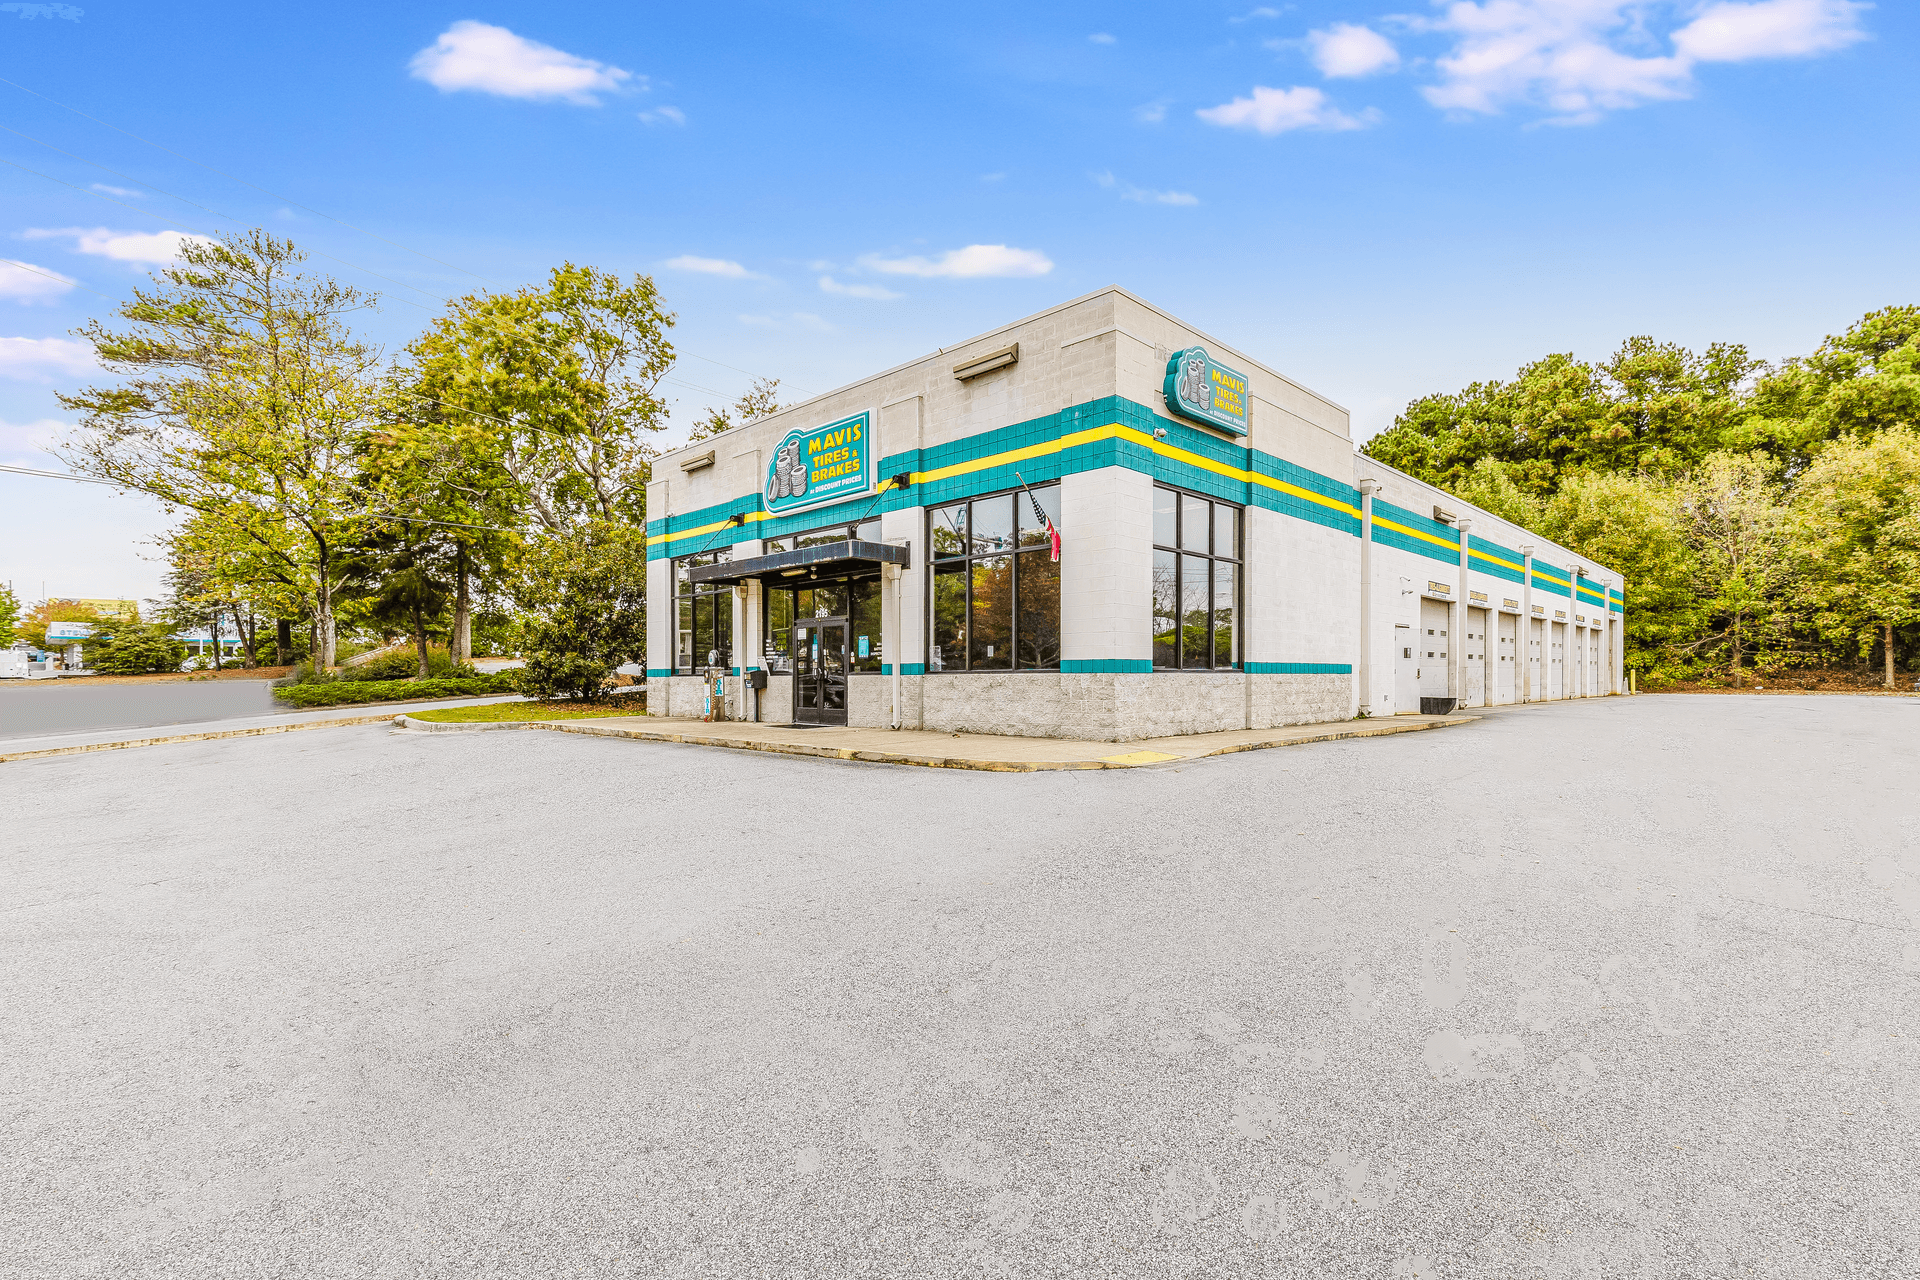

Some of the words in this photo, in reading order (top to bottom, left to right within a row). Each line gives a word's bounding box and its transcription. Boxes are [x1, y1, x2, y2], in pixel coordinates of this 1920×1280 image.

[1212, 369, 1244, 394] MAVIS
[1215, 385, 1239, 404] TIRES
[1214, 397, 1243, 417] BRAKES
[808, 423, 861, 455] MAVIS
[812, 447, 850, 468] TIRES
[852, 449, 858, 457] &
[811, 458, 860, 483] BRAKES
[815, 480, 841, 493] DISCOUNT
[841, 474, 862, 486] PRICES
